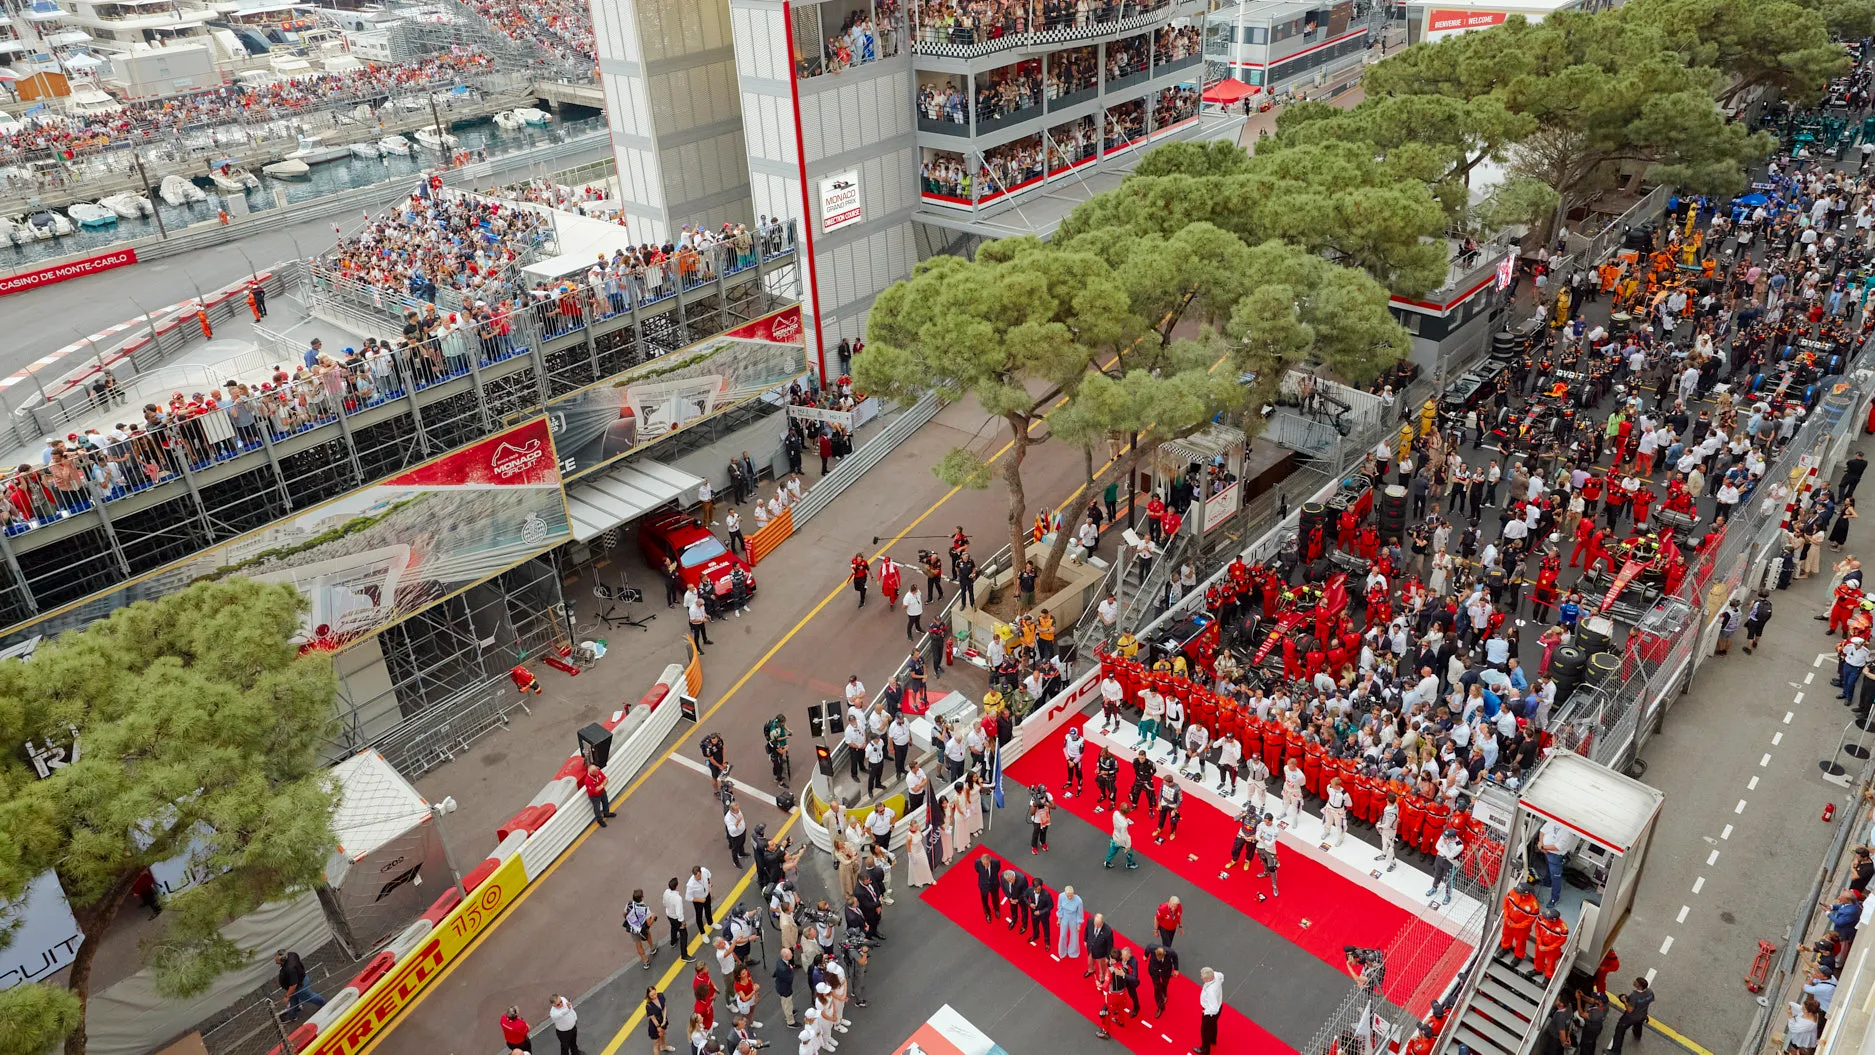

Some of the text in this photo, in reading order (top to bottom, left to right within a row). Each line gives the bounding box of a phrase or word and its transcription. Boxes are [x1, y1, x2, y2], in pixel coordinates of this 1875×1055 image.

[1434, 15, 1493, 28] BIENVENUE WELCOME
[826, 190, 856, 206] MONACO
[826, 198, 857, 213] GRAND PRIX
[0, 254, 127, 290] CASINO DE MONTE-CARLO
[493, 449, 542, 475] MONACO
[501, 459, 537, 479] CIRCUIT
